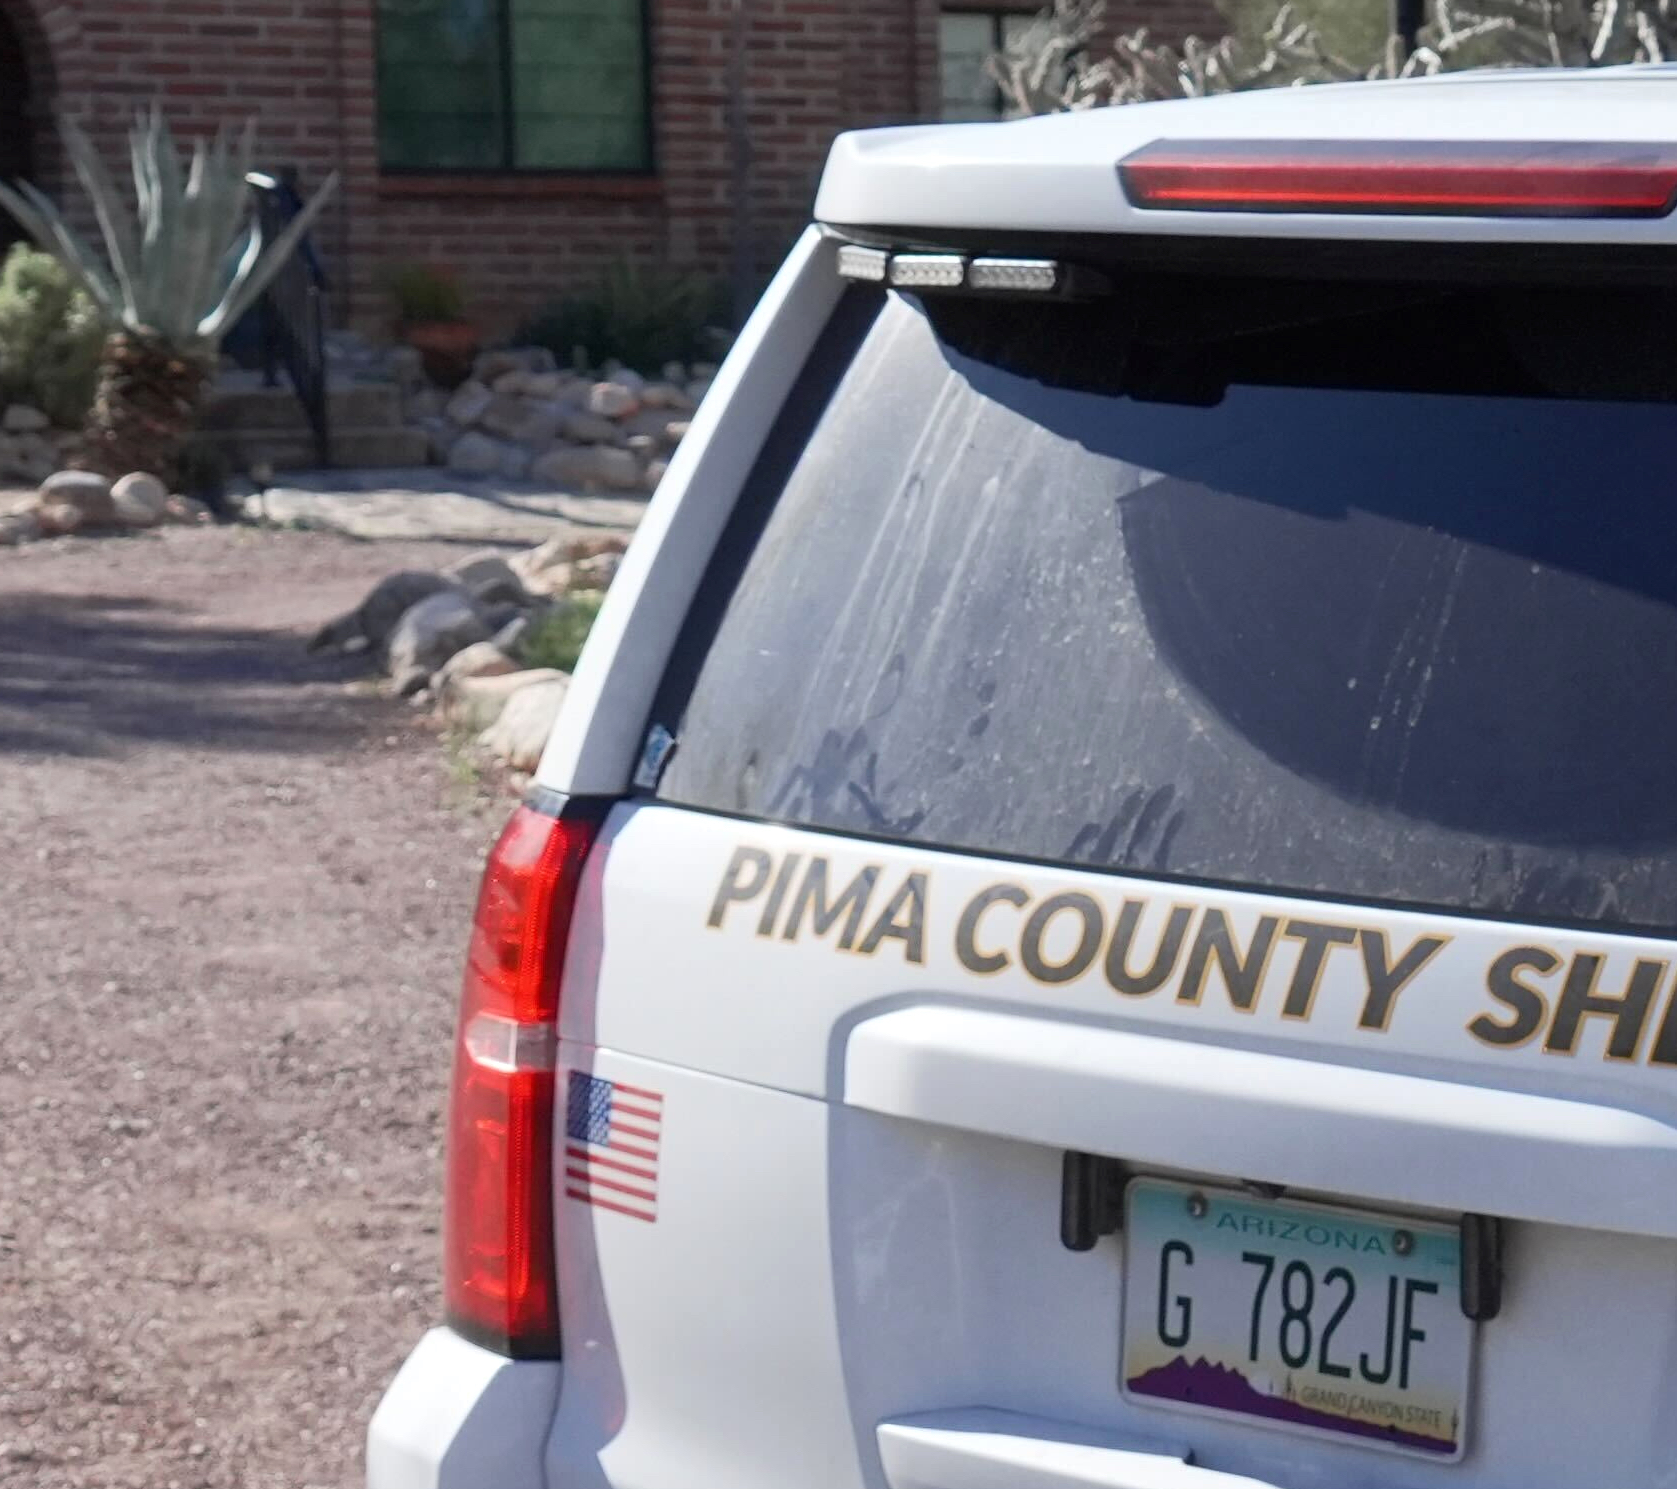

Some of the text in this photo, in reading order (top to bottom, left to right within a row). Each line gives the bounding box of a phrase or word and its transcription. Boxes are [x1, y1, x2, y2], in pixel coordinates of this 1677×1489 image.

[706, 844, 932, 968] PIMA
[953, 882, 1455, 1034] COUNTY
[1216, 1212, 1386, 1256] ARIZONA
[1157, 1238, 1439, 1390] G 782JF
[1300, 1384, 1348, 1410] GRAND
[1350, 1393, 1404, 1421] CANYON
